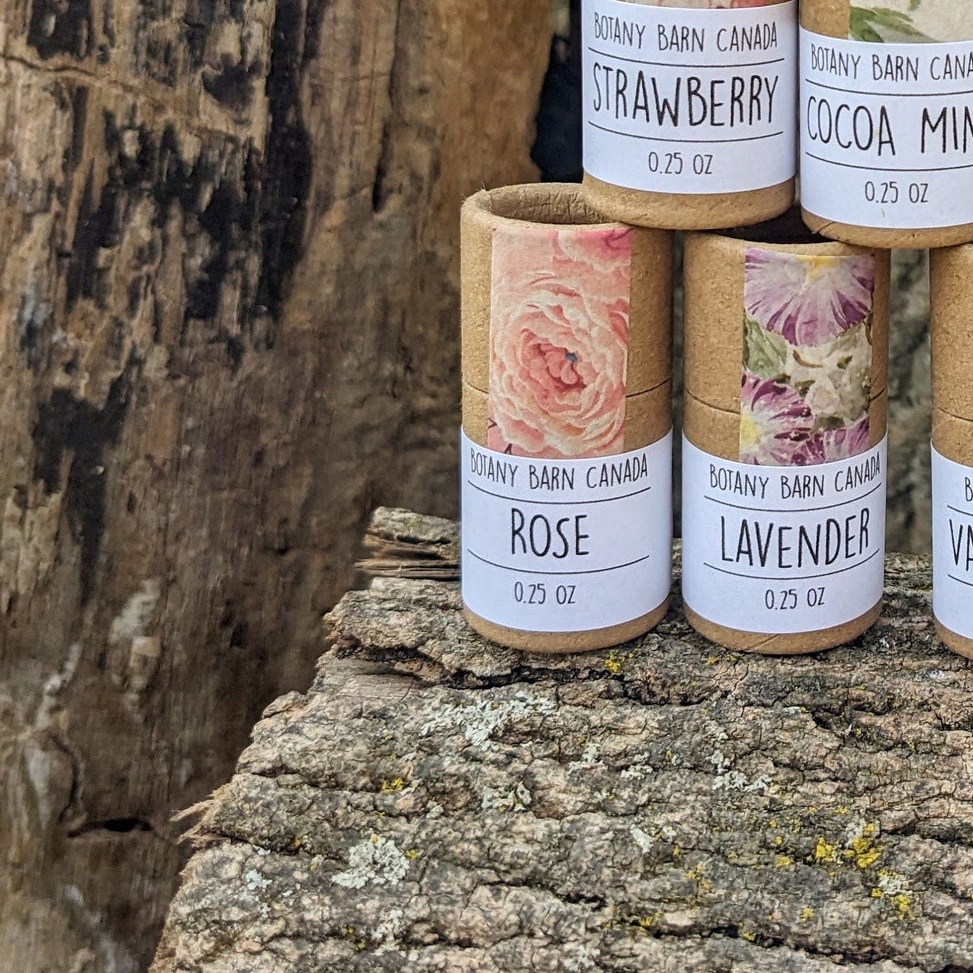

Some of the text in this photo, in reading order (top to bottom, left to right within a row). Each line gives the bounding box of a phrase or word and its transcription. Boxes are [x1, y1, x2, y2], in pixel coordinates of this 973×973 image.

[594, 12, 777, 52] BOTANY BARN CANADA
[811, 43, 861, 79] BOTANY
[872, 54, 919, 82] BARN
[593, 62, 779, 127] STRAWBERRY
[807, 96, 896, 156] COCOA
[648, 152, 713, 174] 0.25 OZ
[865, 181, 928, 203] 0.25 OZ
[470, 447, 648, 491] BOTANY BARN CANADA
[710, 452, 880, 499] BOTANY BARN CANADA
[511, 508, 589, 559] ROSE
[721, 507, 870, 568] LAVENDER
[514, 581, 576, 604] 0.25 OZ
[765, 587, 825, 610] 0.25 OZ
